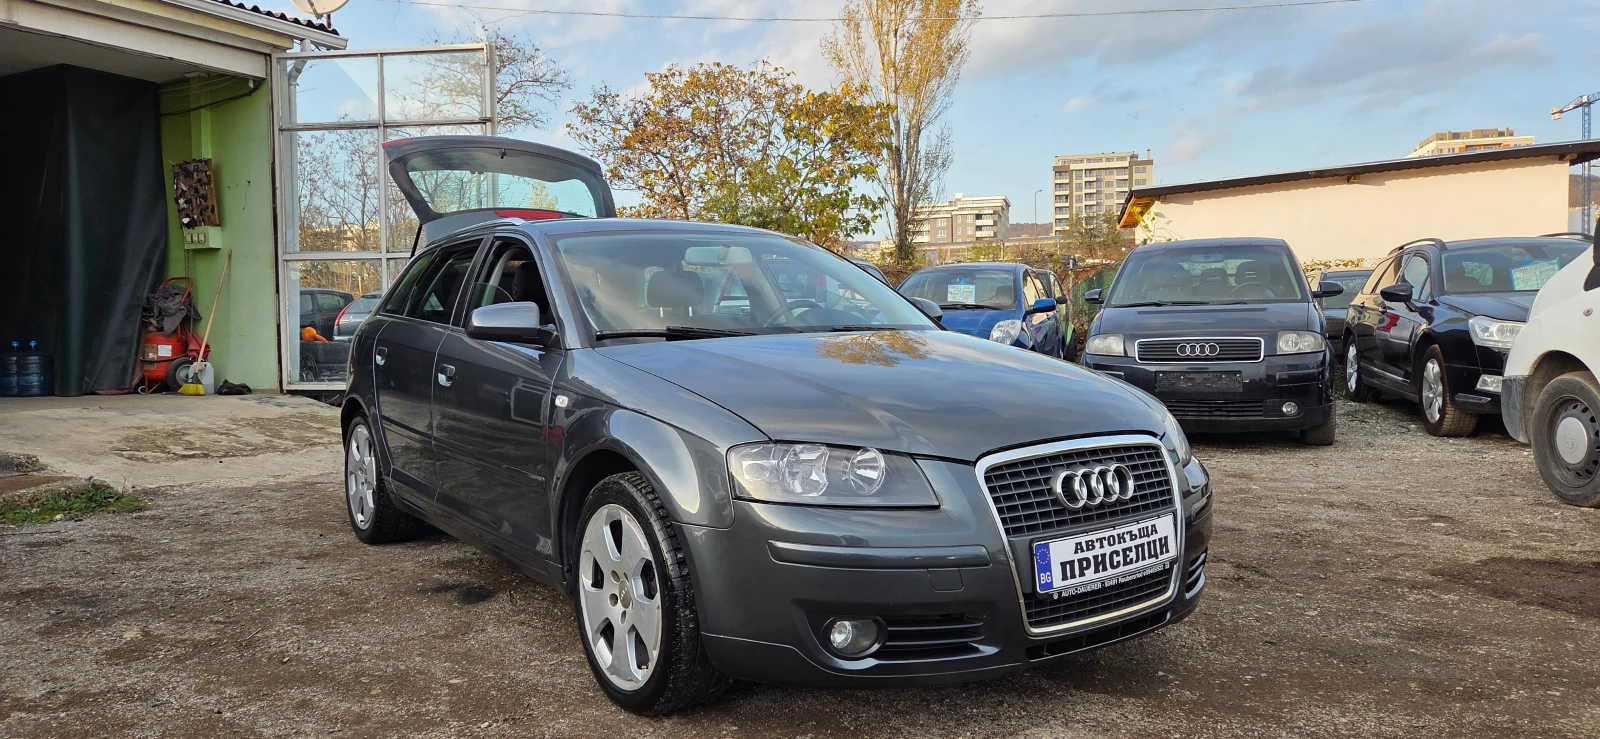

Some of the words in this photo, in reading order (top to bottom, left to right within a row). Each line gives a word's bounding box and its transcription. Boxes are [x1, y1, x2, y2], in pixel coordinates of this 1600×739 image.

[1074, 524, 1158, 554] АВТОКЪЩА
[1060, 536, 1170, 581] ПРИСЕЛЦИ
[1040, 572, 1051, 584] BG
[1061, 582, 1102, 597] AUTO-DAUERER
